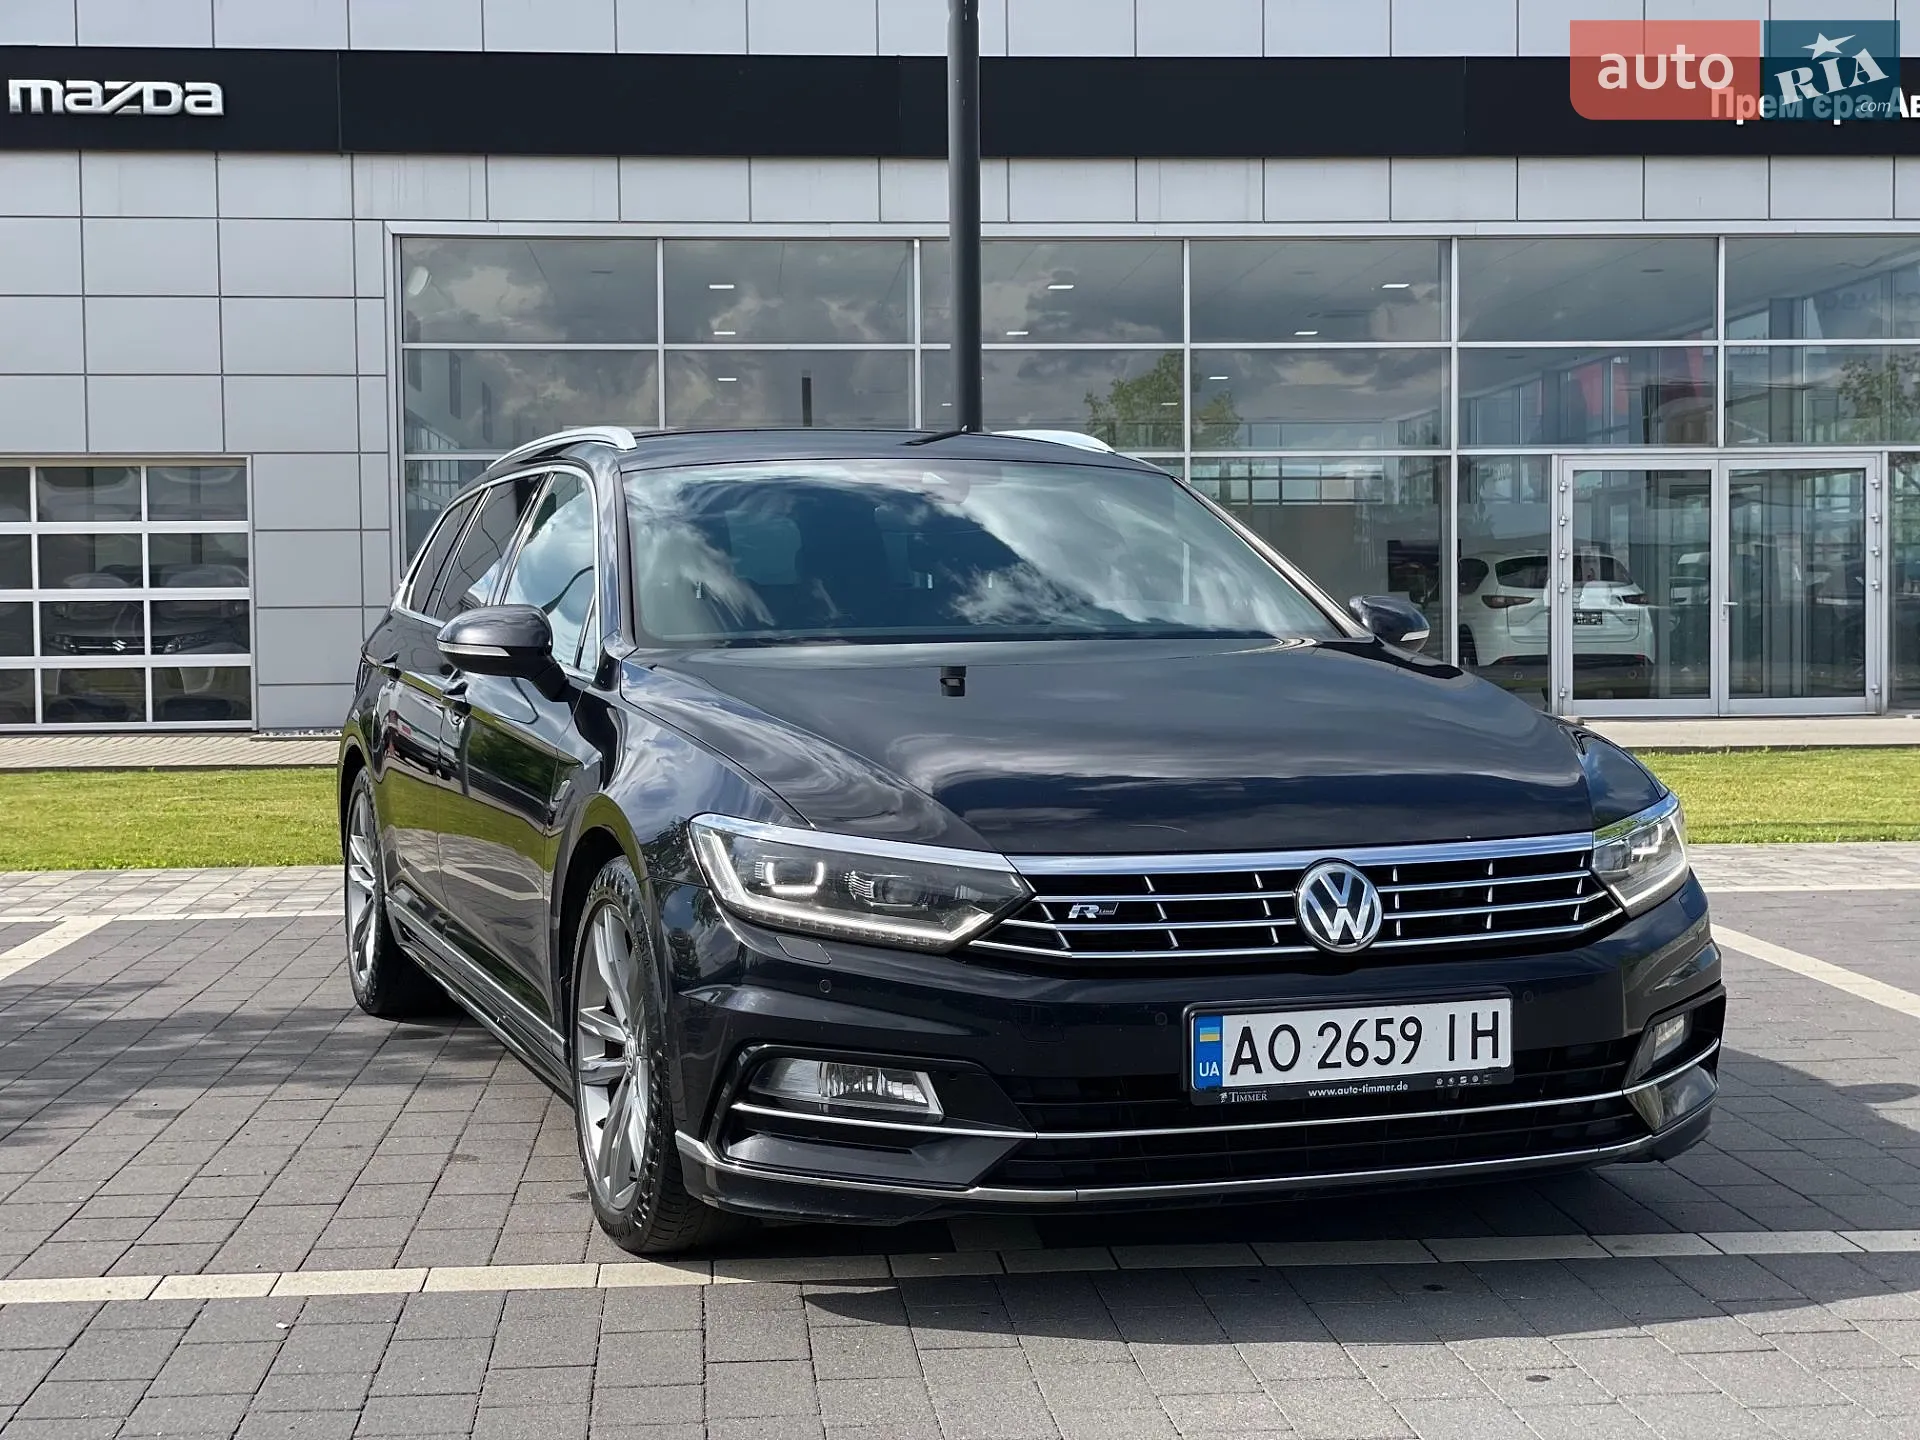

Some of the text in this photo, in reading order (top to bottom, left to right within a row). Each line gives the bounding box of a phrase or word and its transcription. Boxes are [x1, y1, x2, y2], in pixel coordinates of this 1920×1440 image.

[1229, 1010, 1499, 1076] AO 2659 IH
[1199, 1061, 1220, 1078] UA
[1308, 1081, 1409, 1097] www.auto-timmer.de
